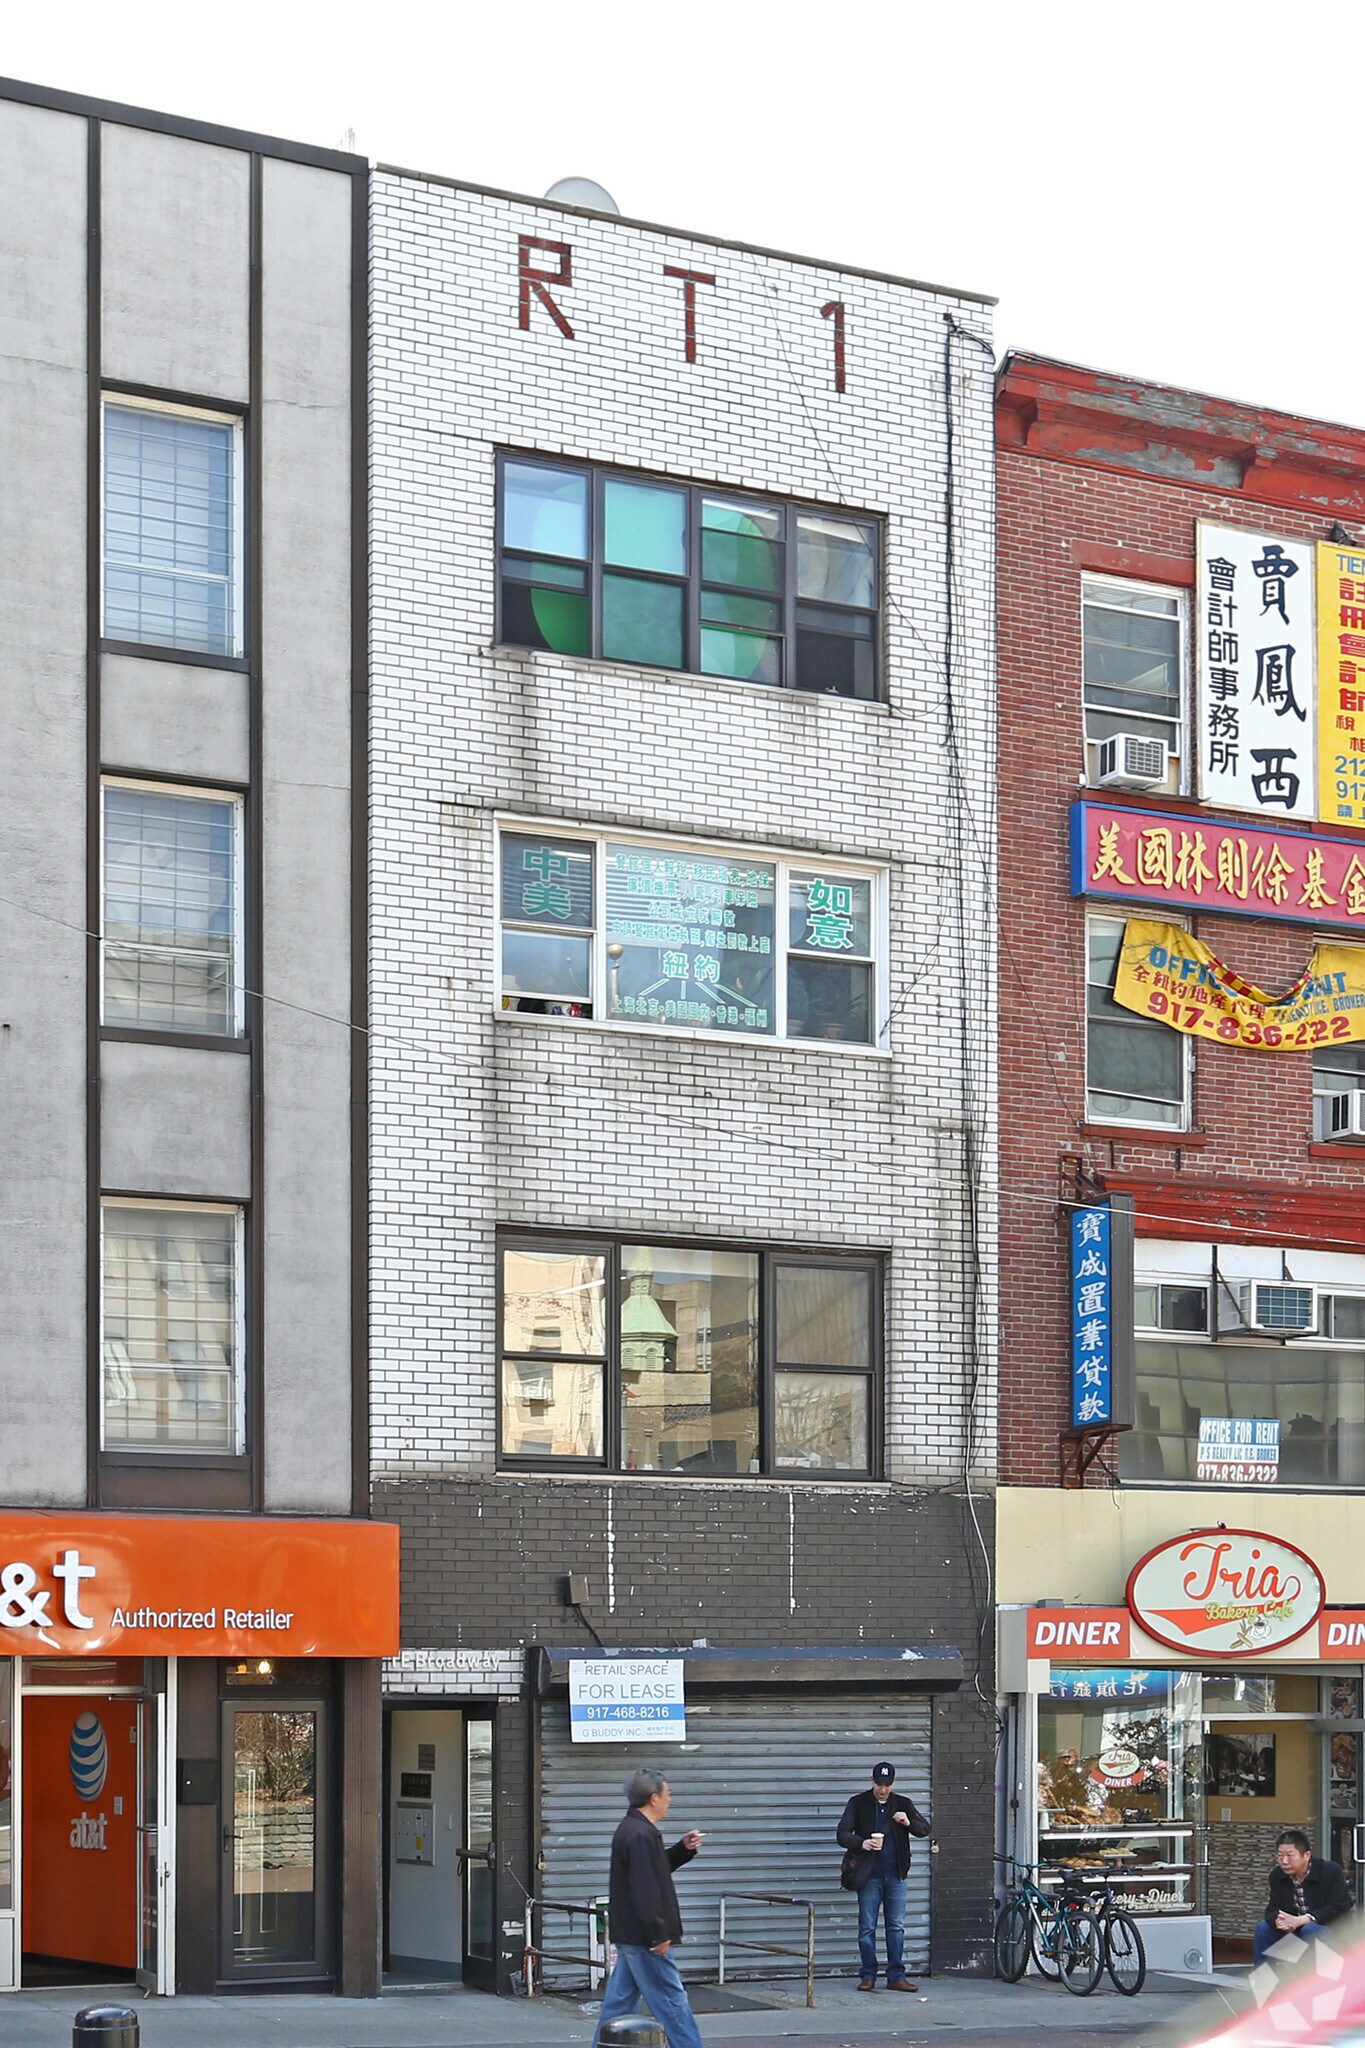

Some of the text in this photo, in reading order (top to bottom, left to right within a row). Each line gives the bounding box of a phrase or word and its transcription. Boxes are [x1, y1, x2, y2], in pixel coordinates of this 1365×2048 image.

[1206, 556, 1241, 778] 會計師事務所
[1249, 544, 1307, 810] 賈鳳西
[1091, 820, 1365, 916] 美國林則徐基金
[522, 846, 572, 920] 中美
[805, 877, 855, 950] 如意
[662, 949, 721, 983] 紐約
[1149, 946, 1238, 996] OFFIC
[1074, 1212, 1109, 1423] 寶成置業貸款
[1199, 1419, 1279, 1444] OFFICE FOR RENT
[1178, 1541, 1302, 1601] Tria
[110, 1607, 294, 1631] Authorized Retailer
[1204, 1600, 1259, 1625] Bakery
[1034, 1621, 1121, 1646] DINER
[415, 1652, 500, 1671] Broadway
[585, 1664, 668, 1676] RETAIL SPACE
[578, 1683, 676, 1699] FOR LEASE
[586, 1706, 669, 1719] 917-468-8216
[592, 1728, 624, 1737] BUDDY
[1103, 1777, 1133, 1787] DINER
[69, 1811, 108, 1850] at&t
[1146, 1888, 1185, 1904] Diner
